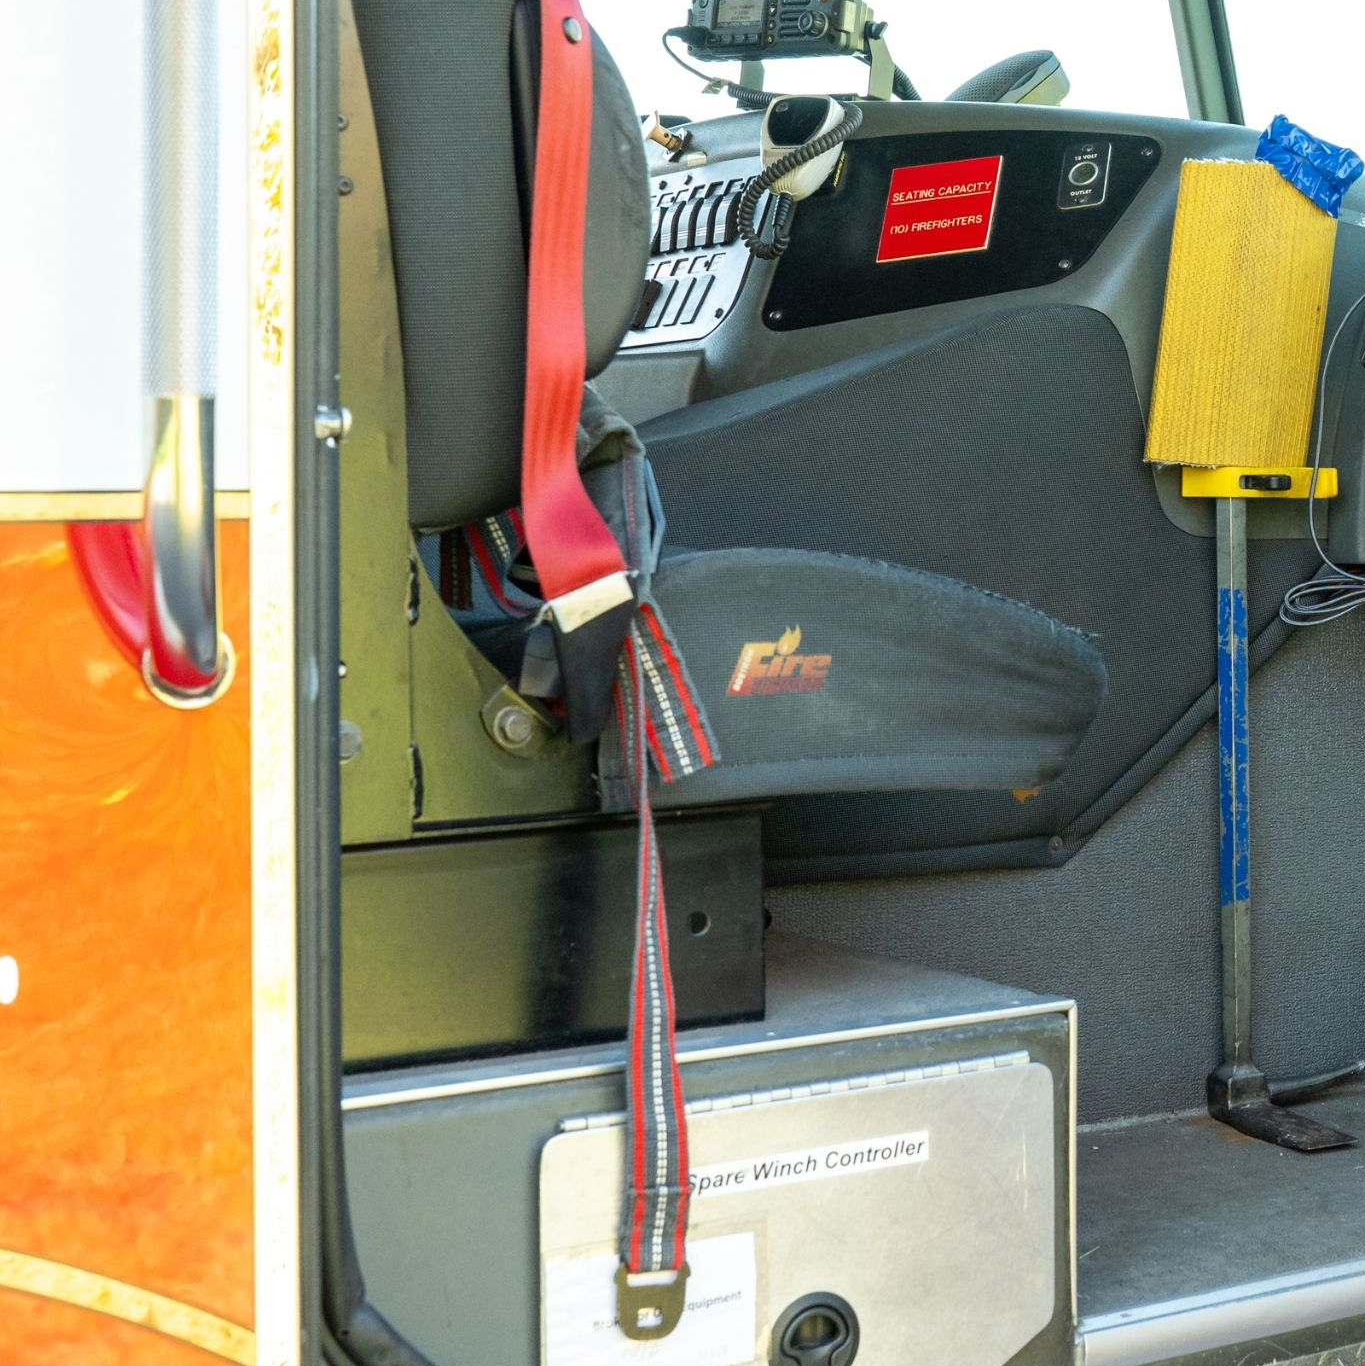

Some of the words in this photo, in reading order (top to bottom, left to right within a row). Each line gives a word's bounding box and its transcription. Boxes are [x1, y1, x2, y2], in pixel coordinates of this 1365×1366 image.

[892, 188, 935, 202] SEATING
[938, 181, 992, 195] CAPACITY
[890, 224, 909, 235] (10)
[911, 214, 983, 232] FIREFIGHTERS
[726, 625, 832, 696] Fire
[687, 1169, 745, 1195] Spare
[753, 1156, 817, 1181] Winch
[825, 1140, 925, 1169] Controller
[685, 1290, 742, 1312] quipment
